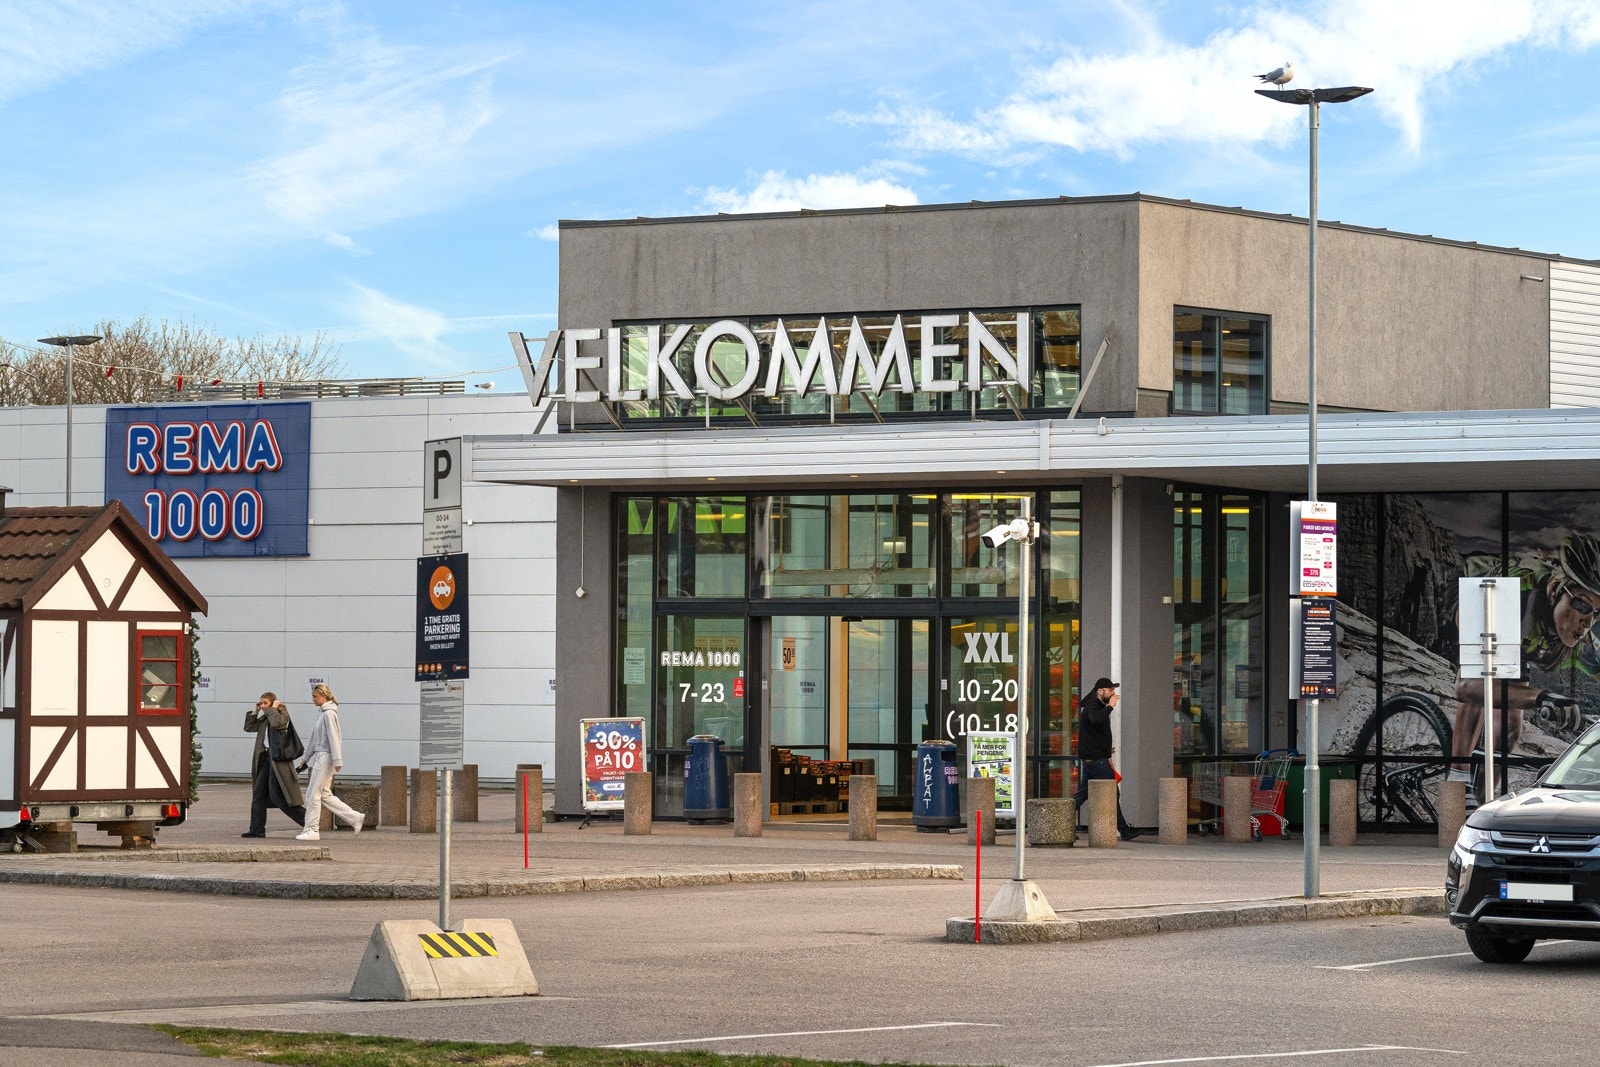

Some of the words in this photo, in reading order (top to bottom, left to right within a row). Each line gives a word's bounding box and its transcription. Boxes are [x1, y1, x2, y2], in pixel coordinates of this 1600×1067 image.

[508, 311, 1030, 407] VELKOMMEN
[126, 418, 283, 475] REMA
[433, 449, 452, 500] P
[143, 487, 263, 542] 1000
[424, 616, 429, 625] 1
[429, 615, 441, 625] TIME
[442, 614, 460, 623] GRATIS
[424, 623, 460, 635] PARKERING
[964, 632, 1013, 663] XXL
[660, 651, 705, 667] REMA
[706, 651, 741, 667] 1000
[679, 682, 725, 703] 7-23
[958, 679, 1019, 702] 10-20
[589, 731, 636, 750] -30%
[594, 750, 613, 767] PÅ
[613, 751, 635, 769] 10
[943, 766, 958, 776] RE
